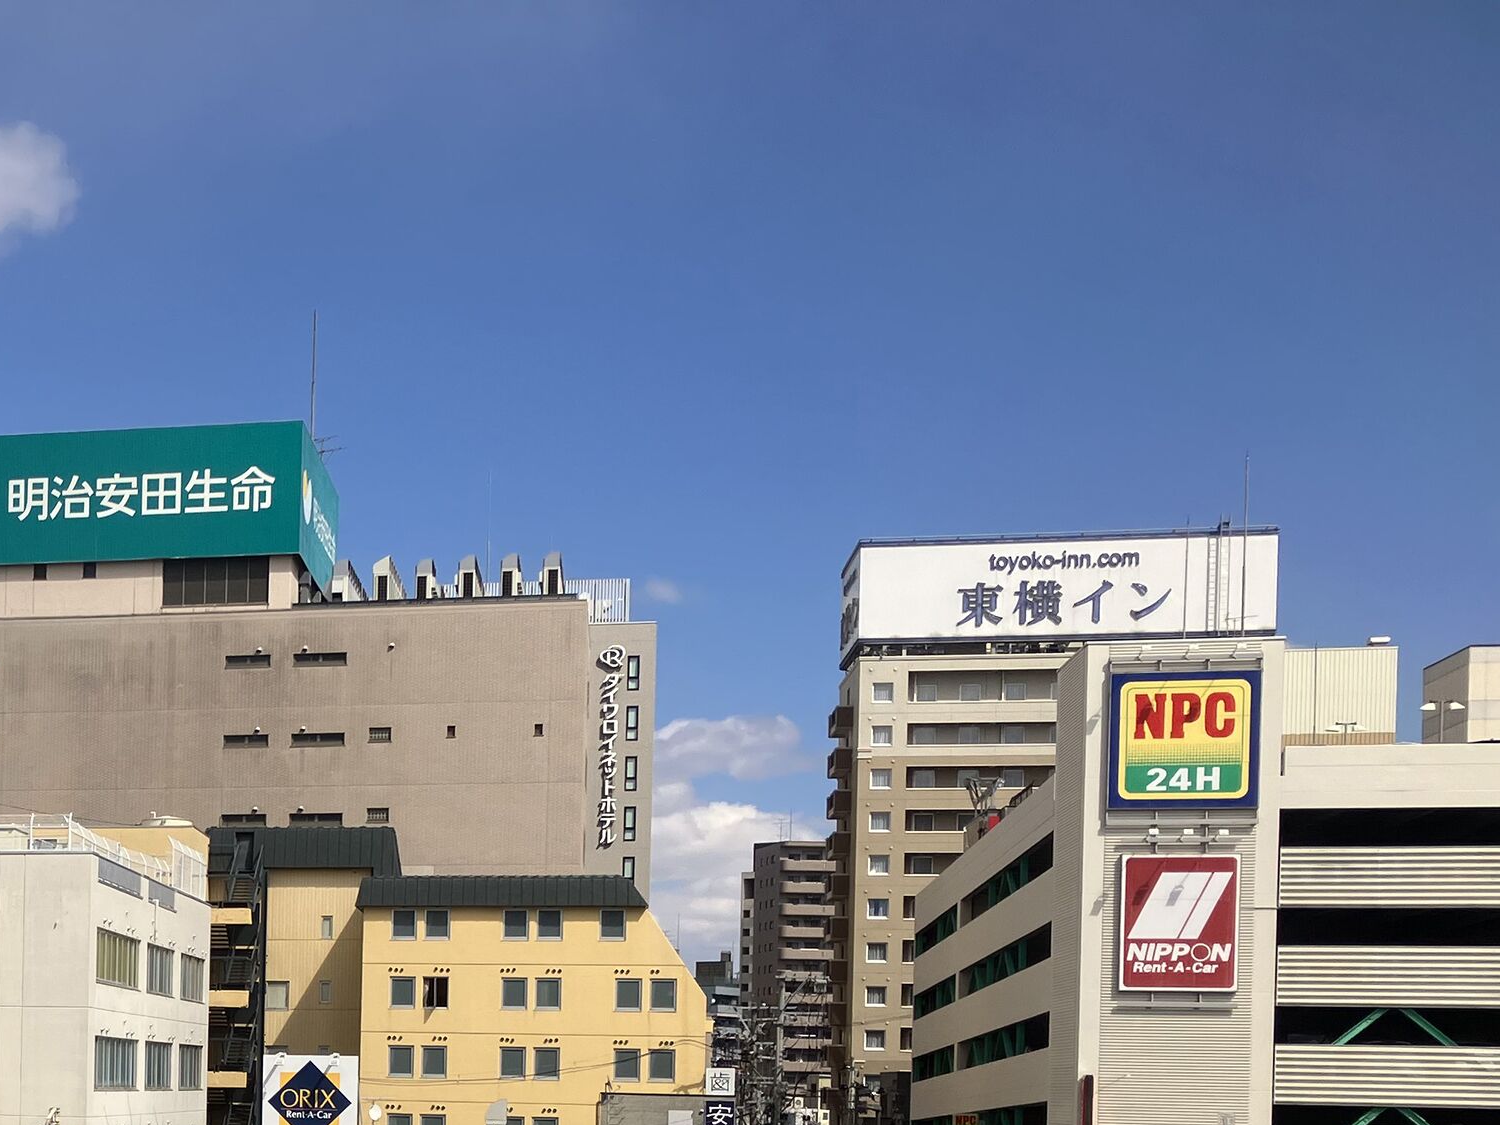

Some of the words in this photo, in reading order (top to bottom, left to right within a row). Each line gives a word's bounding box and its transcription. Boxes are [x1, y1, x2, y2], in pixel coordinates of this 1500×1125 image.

[7, 465, 276, 522] 明治安田生命
[989, 550, 1140, 575] toyoko-inn.com
[956, 579, 1172, 628] 東横イン
[1133, 691, 1236, 740] NPC
[600, 672, 625, 844] ダイワロイネットホテル
[1145, 766, 1221, 792] 24H
[1126, 942, 1232, 963] NIPPON
[1132, 961, 1219, 974] Rent-A-Car
[280, 1088, 336, 1108] ORIX
[286, 1110, 332, 1119] Rent-A-Car
